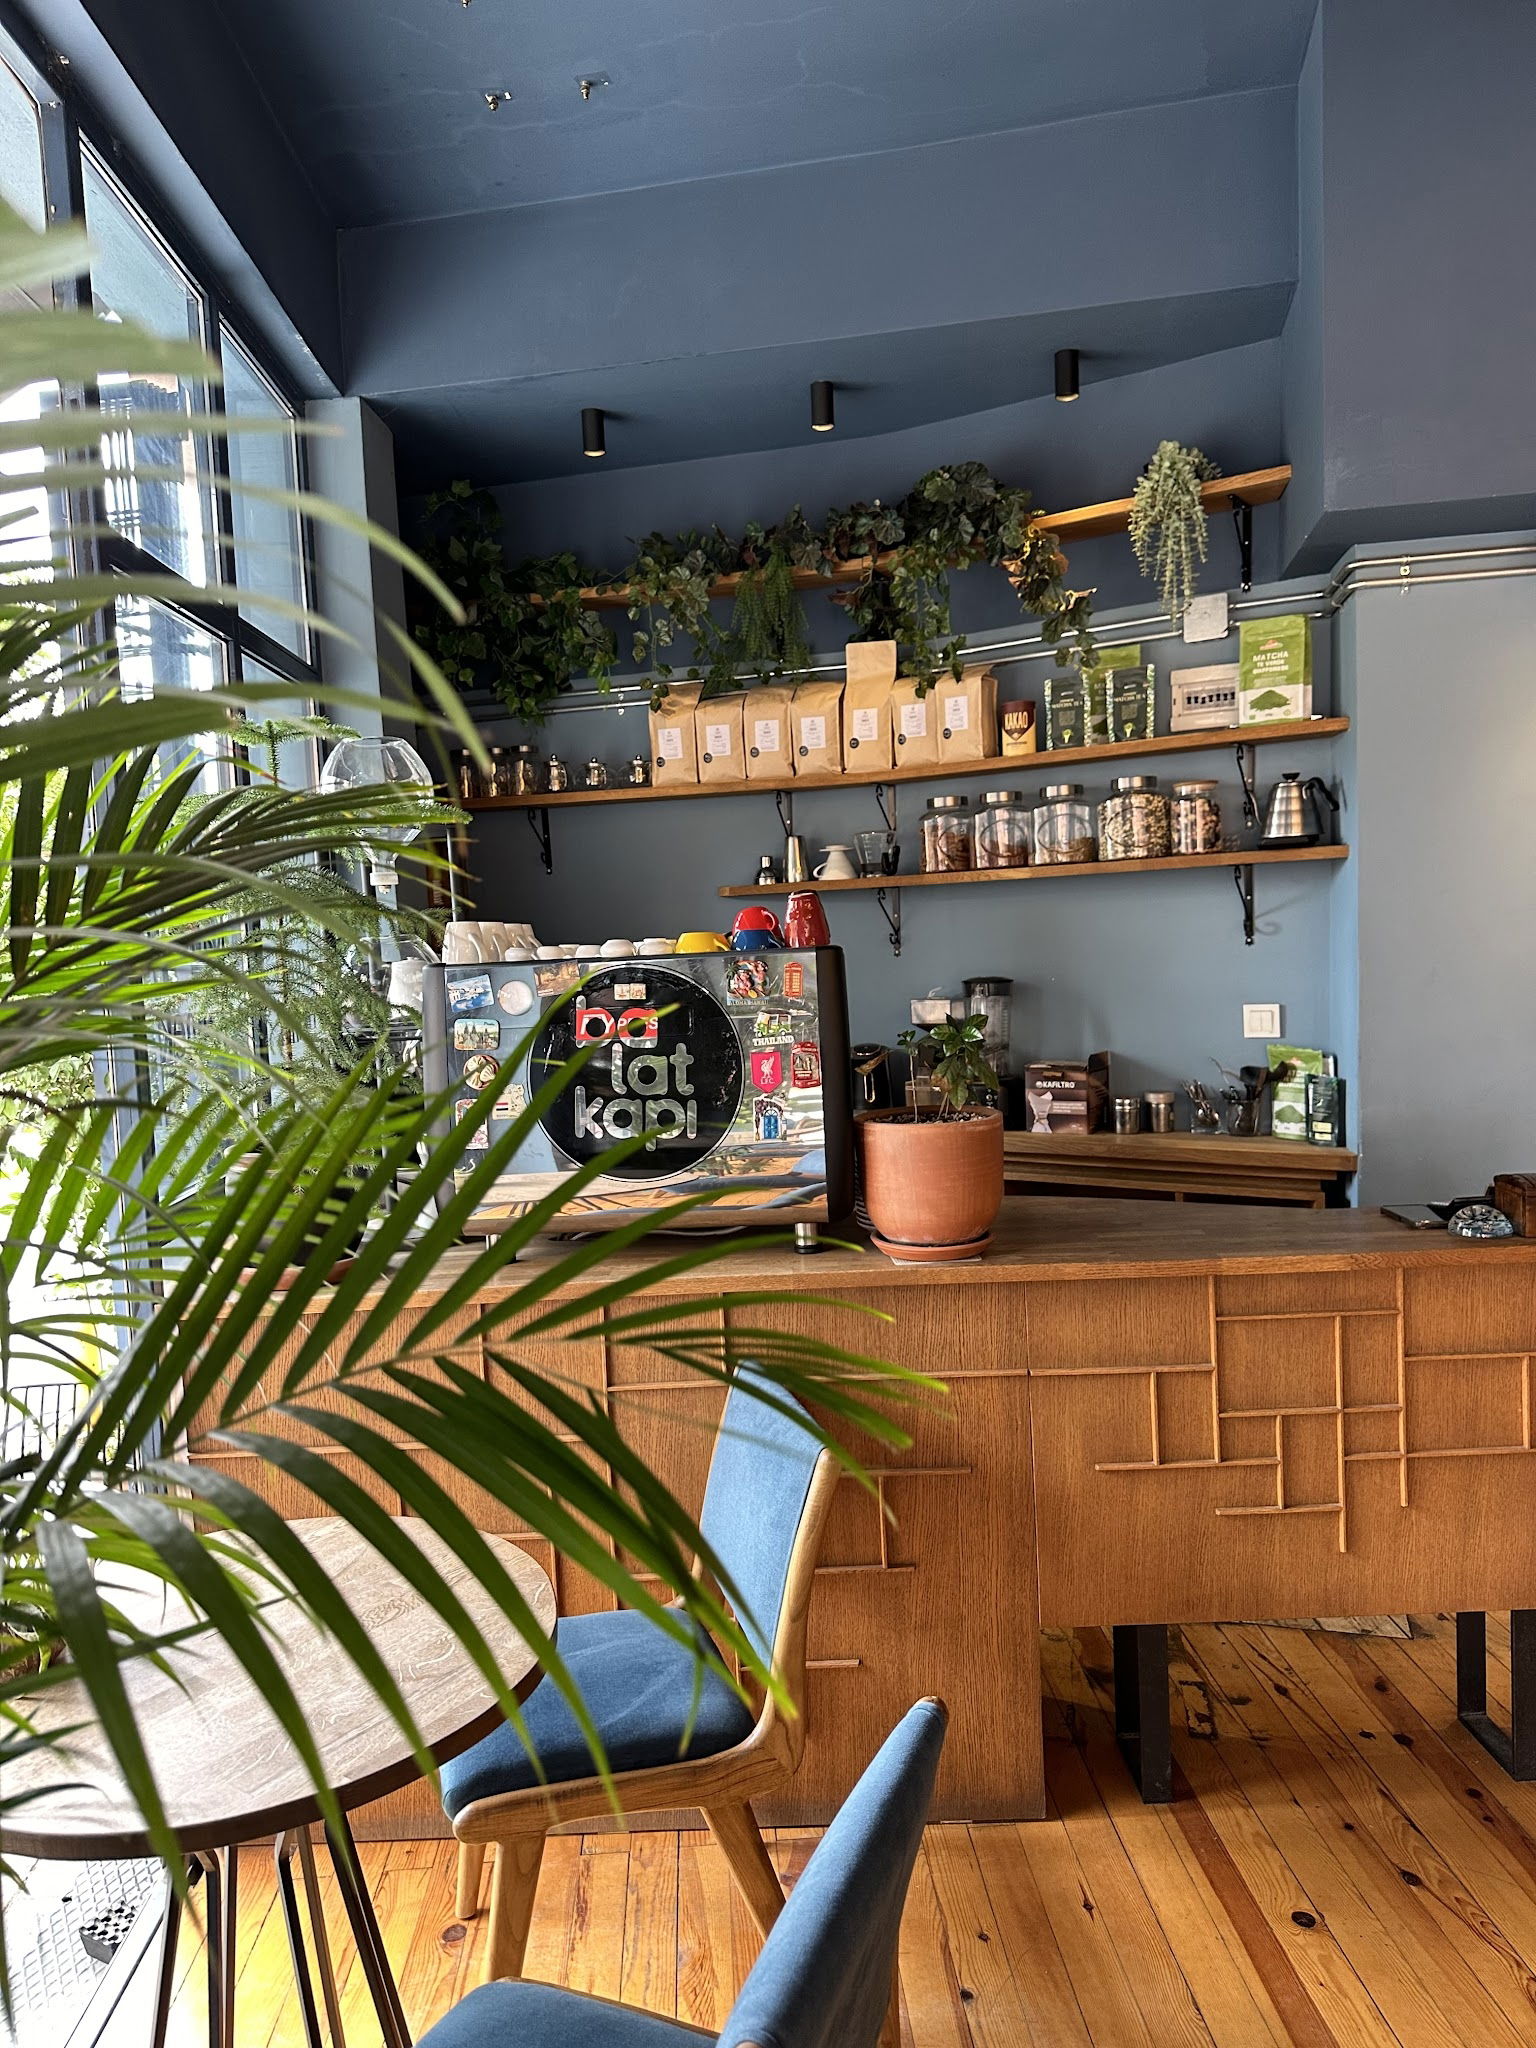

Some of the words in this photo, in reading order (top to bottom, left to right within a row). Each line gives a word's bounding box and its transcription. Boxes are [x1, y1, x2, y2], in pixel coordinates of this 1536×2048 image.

[1253, 650, 1289, 662] MATCHA
[1004, 711, 1029, 730] KAKAO
[752, 1035, 795, 1046] THAILAND
[611, 1042, 694, 1096] lat
